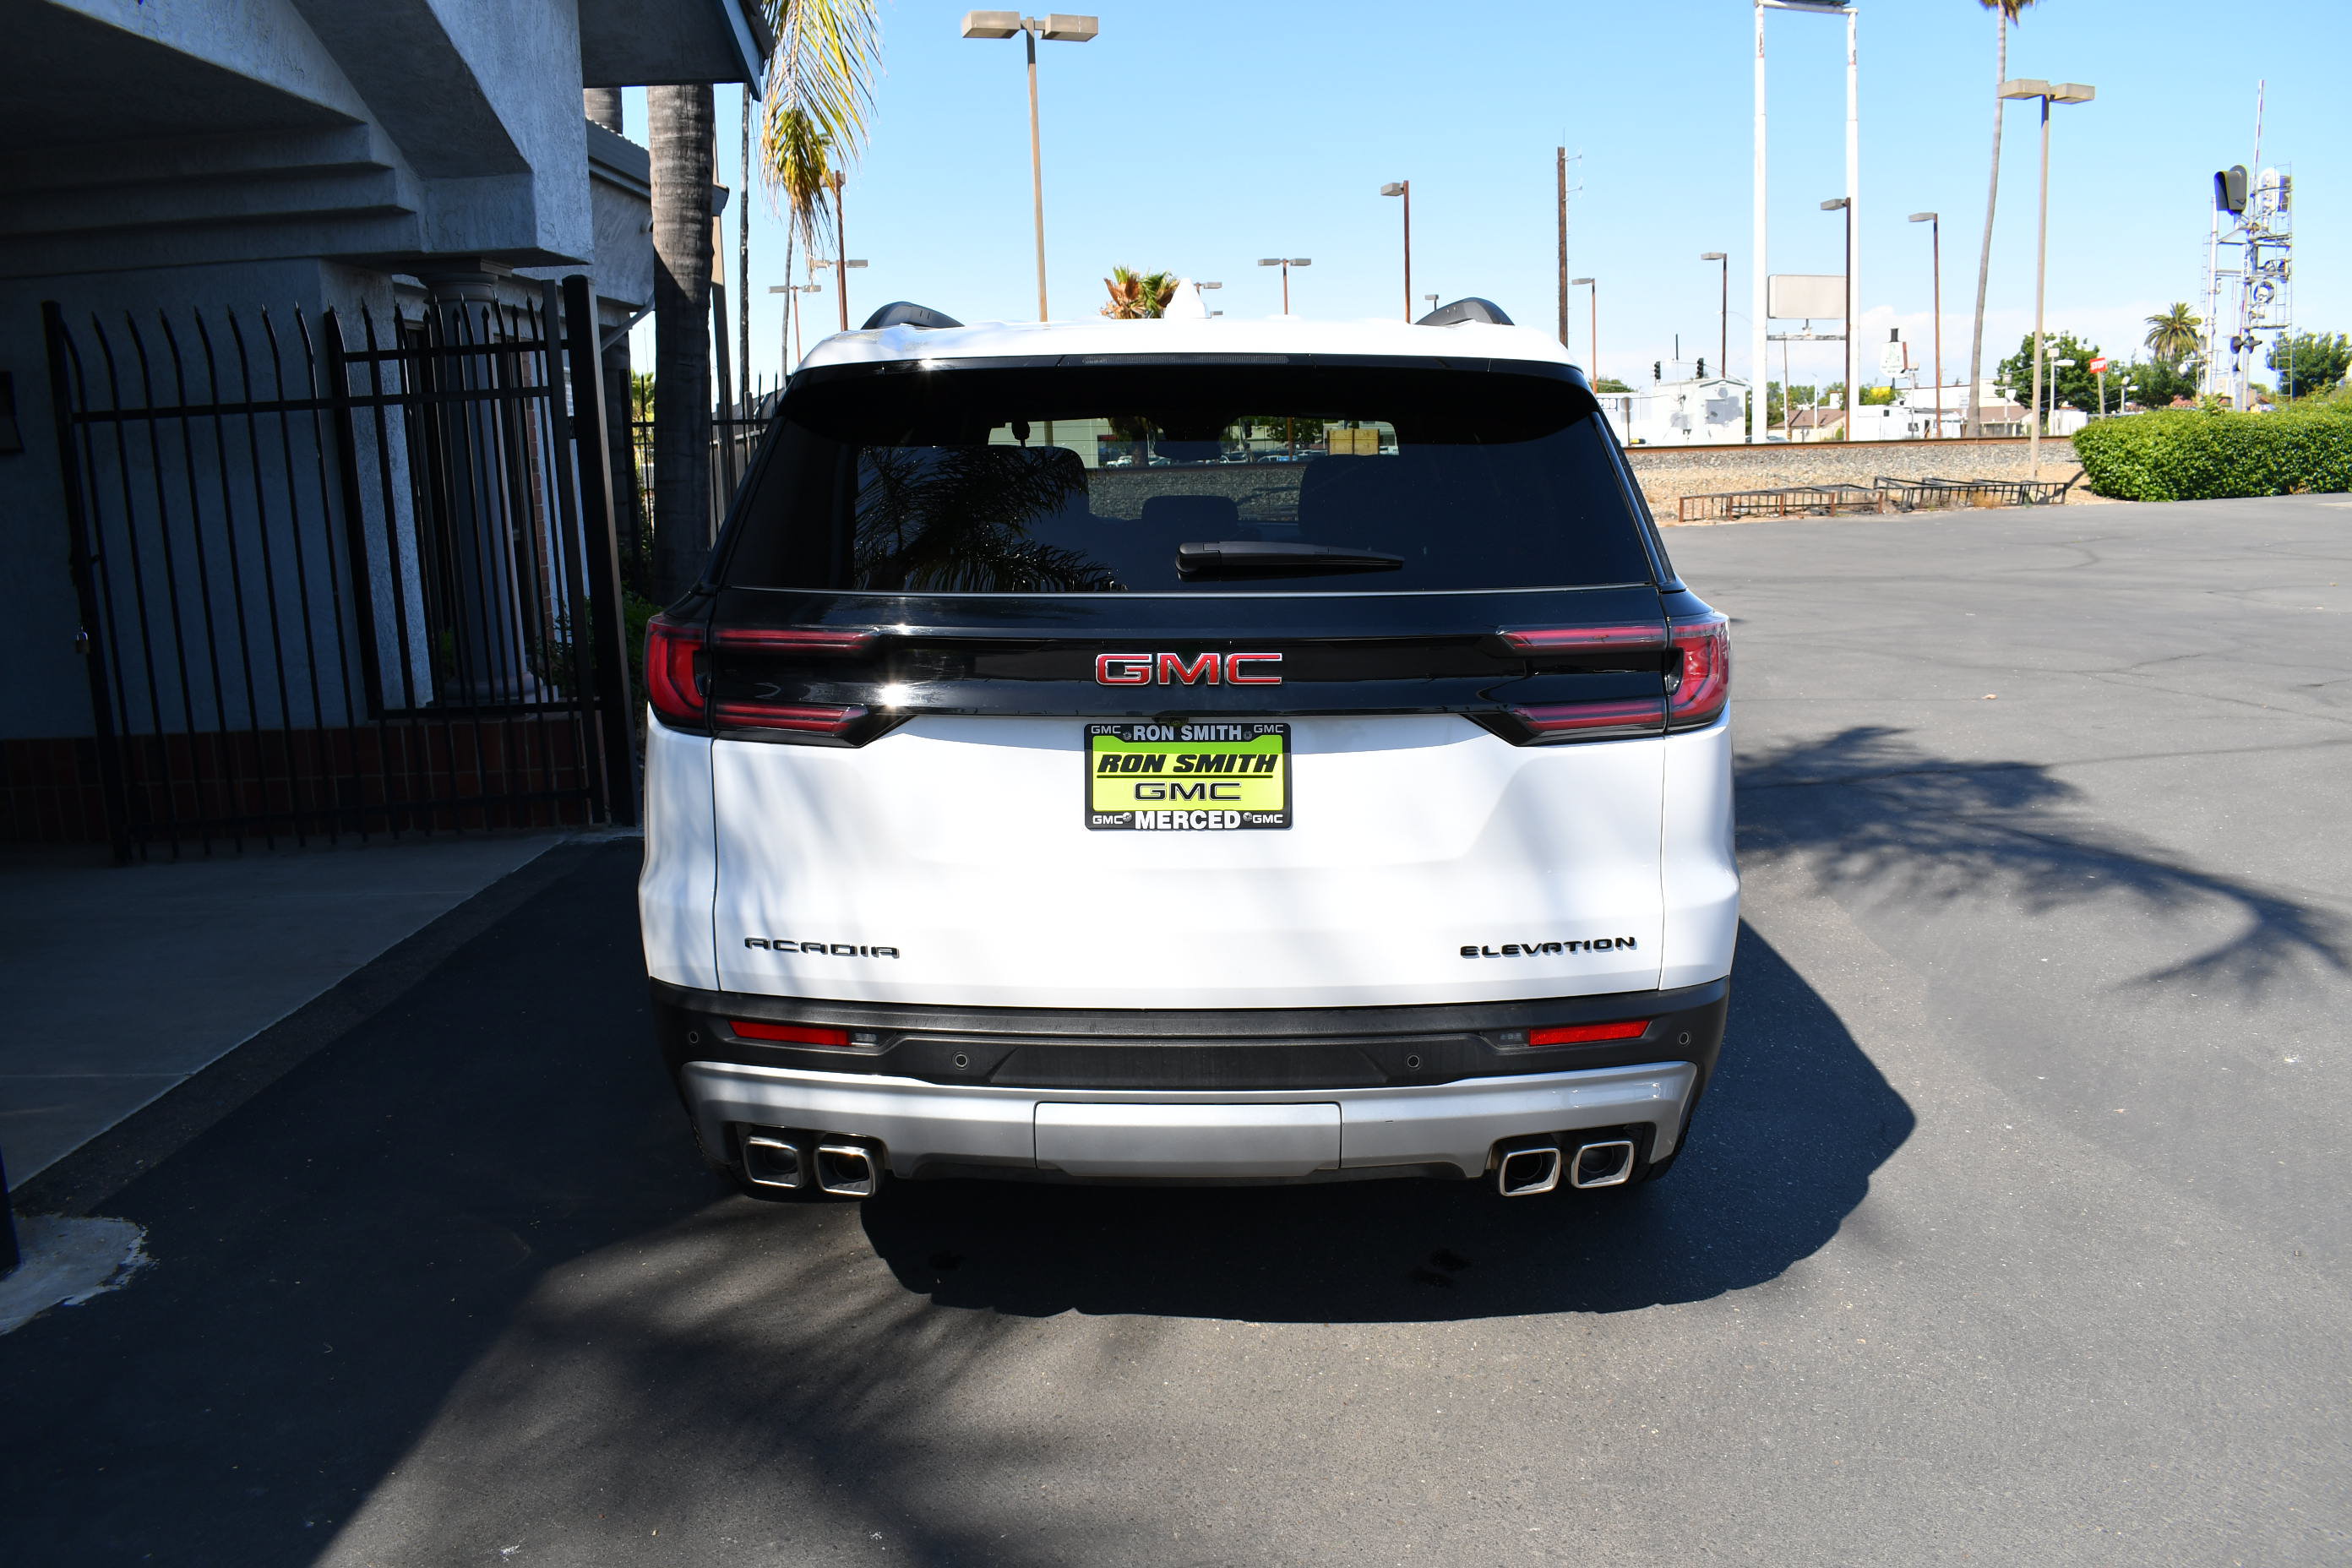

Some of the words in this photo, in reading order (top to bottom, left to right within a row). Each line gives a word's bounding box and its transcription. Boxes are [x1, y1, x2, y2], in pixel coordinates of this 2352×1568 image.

[1096, 653, 1282, 685] GMC
[1091, 725, 1121, 734] GMC
[1133, 725, 1174, 741] RON
[1181, 725, 1241, 741] SMITH
[1254, 724, 1283, 733] GMC
[1097, 754, 1167, 773] RON
[1173, 754, 1278, 773] SMITH
[1134, 781, 1241, 801] GMC
[1092, 814, 1124, 825] GMC
[1135, 809, 1241, 830] MERCED
[1252, 814, 1283, 824] GMC
[744, 937, 900, 959] ACADIA
[1460, 937, 1636, 958] ELEVATION
